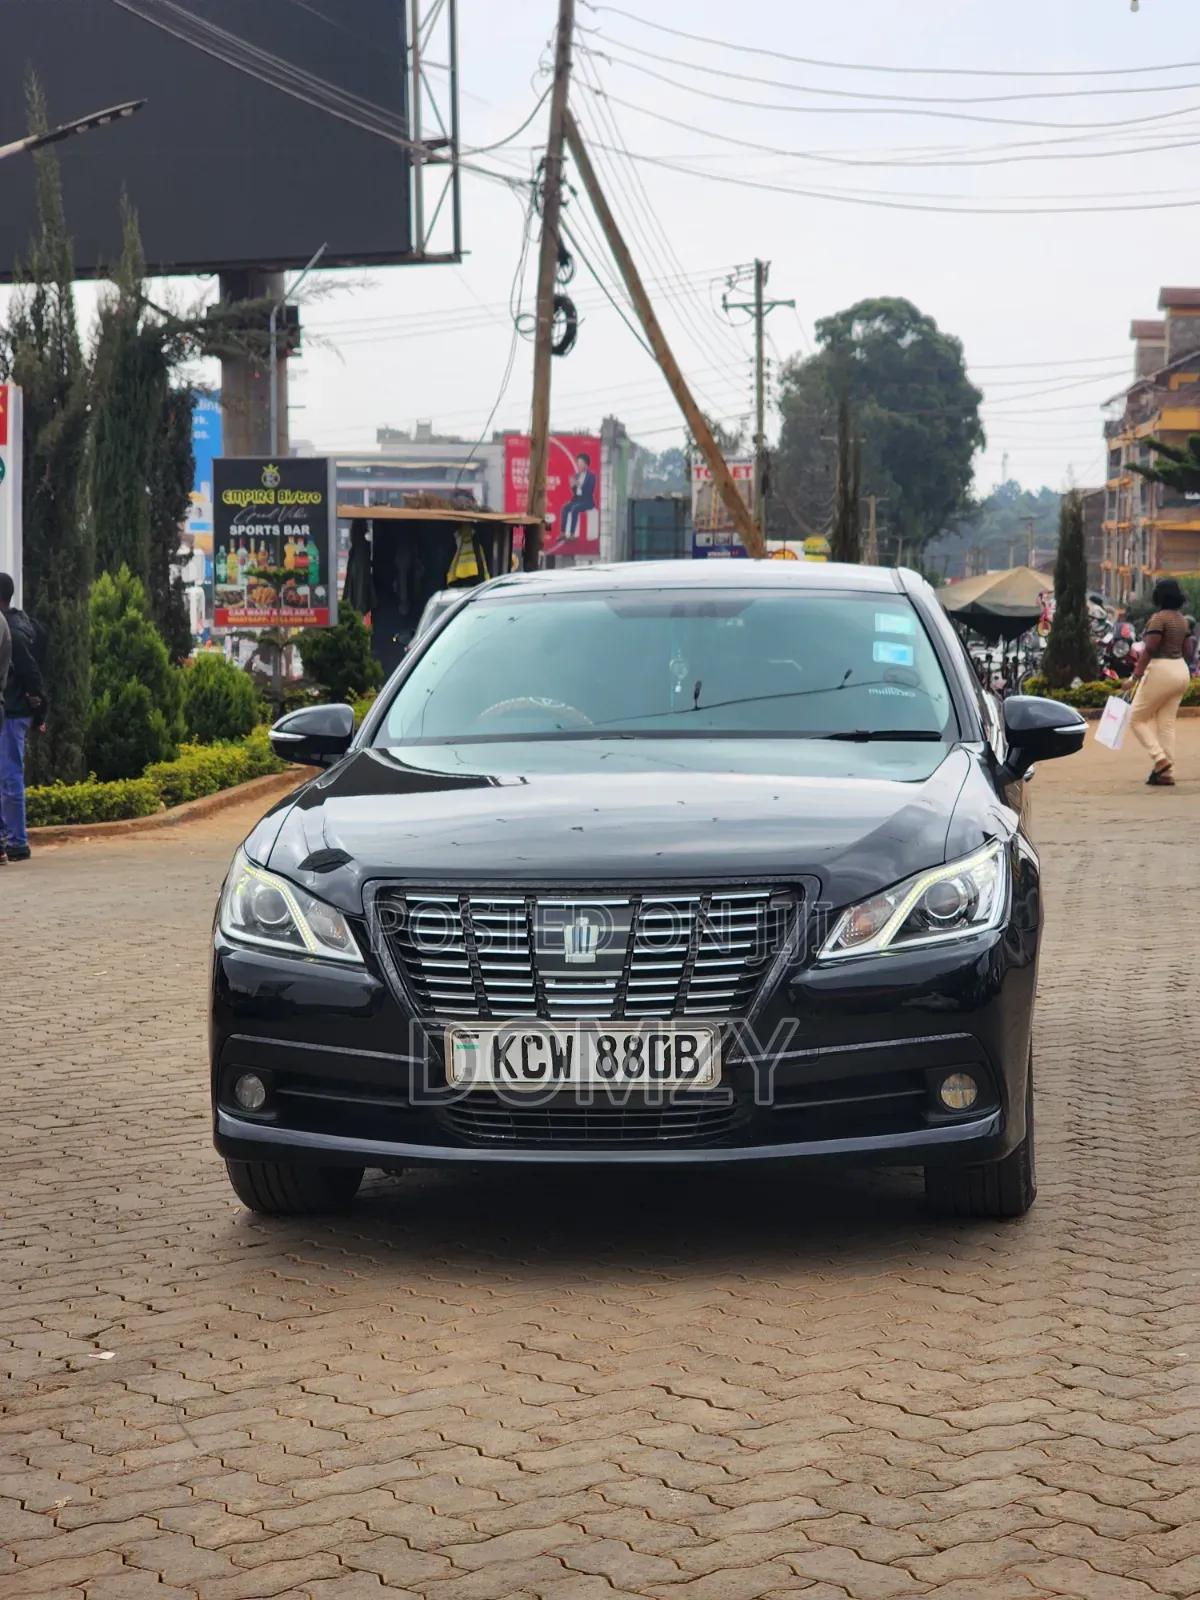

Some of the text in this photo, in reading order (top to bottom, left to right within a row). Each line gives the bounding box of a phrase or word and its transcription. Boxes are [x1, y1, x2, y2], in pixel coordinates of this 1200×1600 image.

[222, 488, 275, 508] EMPIRE
[229, 524, 310, 535] SPORTS BAR
[228, 607, 244, 616] CAR
[246, 607, 270, 616] WASH
[492, 1034, 700, 1079] KCW 880B
